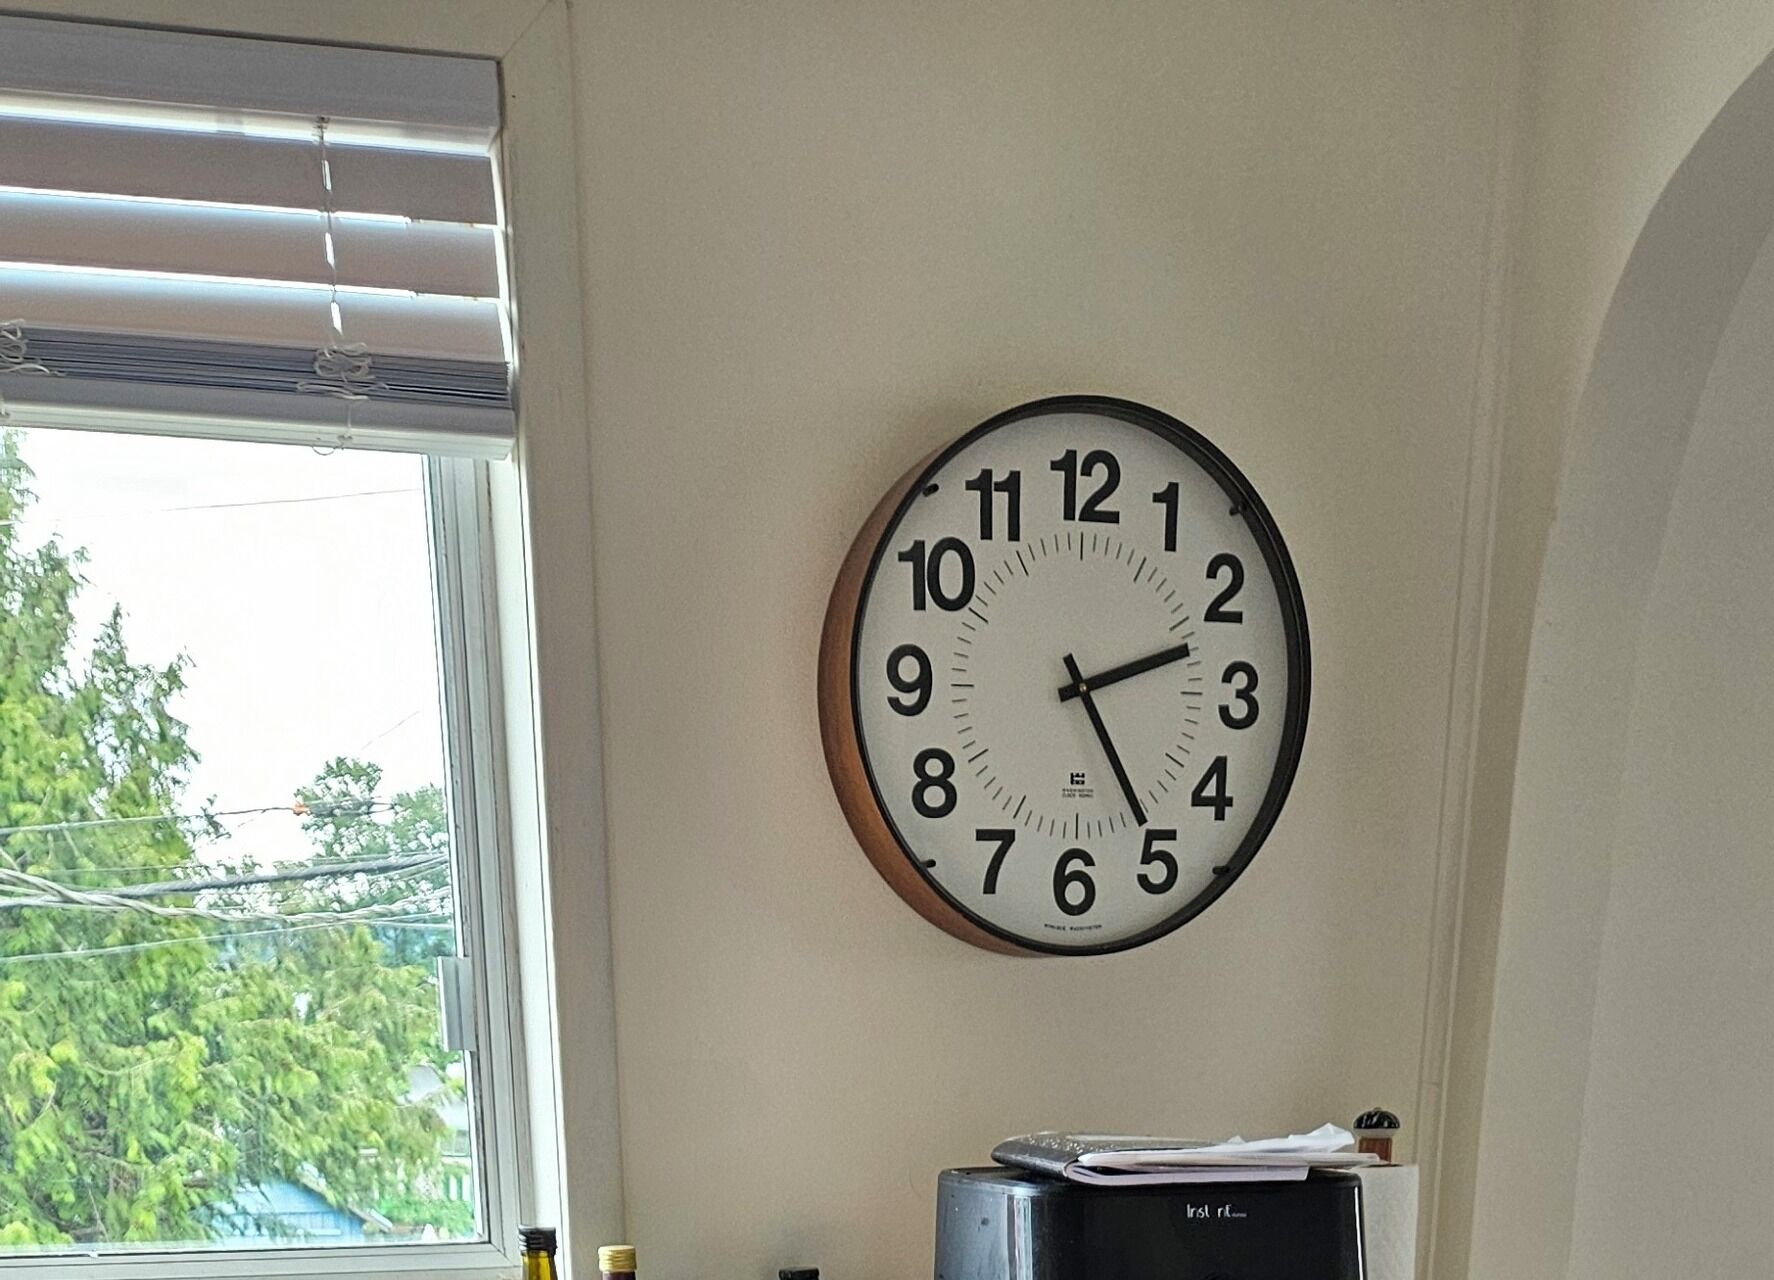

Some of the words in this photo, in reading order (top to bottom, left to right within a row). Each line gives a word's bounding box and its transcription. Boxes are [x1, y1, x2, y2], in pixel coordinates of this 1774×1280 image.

[965, 468, 1022, 541] 11
[1050, 449, 1121, 524] 12
[1152, 481, 1180, 552] 1
[898, 536, 976, 611] 10
[1203, 553, 1245, 624] 2
[886, 643, 933, 717] 9
[1218, 660, 1260, 730] 3
[911, 748, 958, 819] 8
[1191, 755, 1234, 821] 4
[975, 829, 1016, 895] 7
[1052, 848, 1097, 917] 6
[1136, 828, 1179, 895] 5
